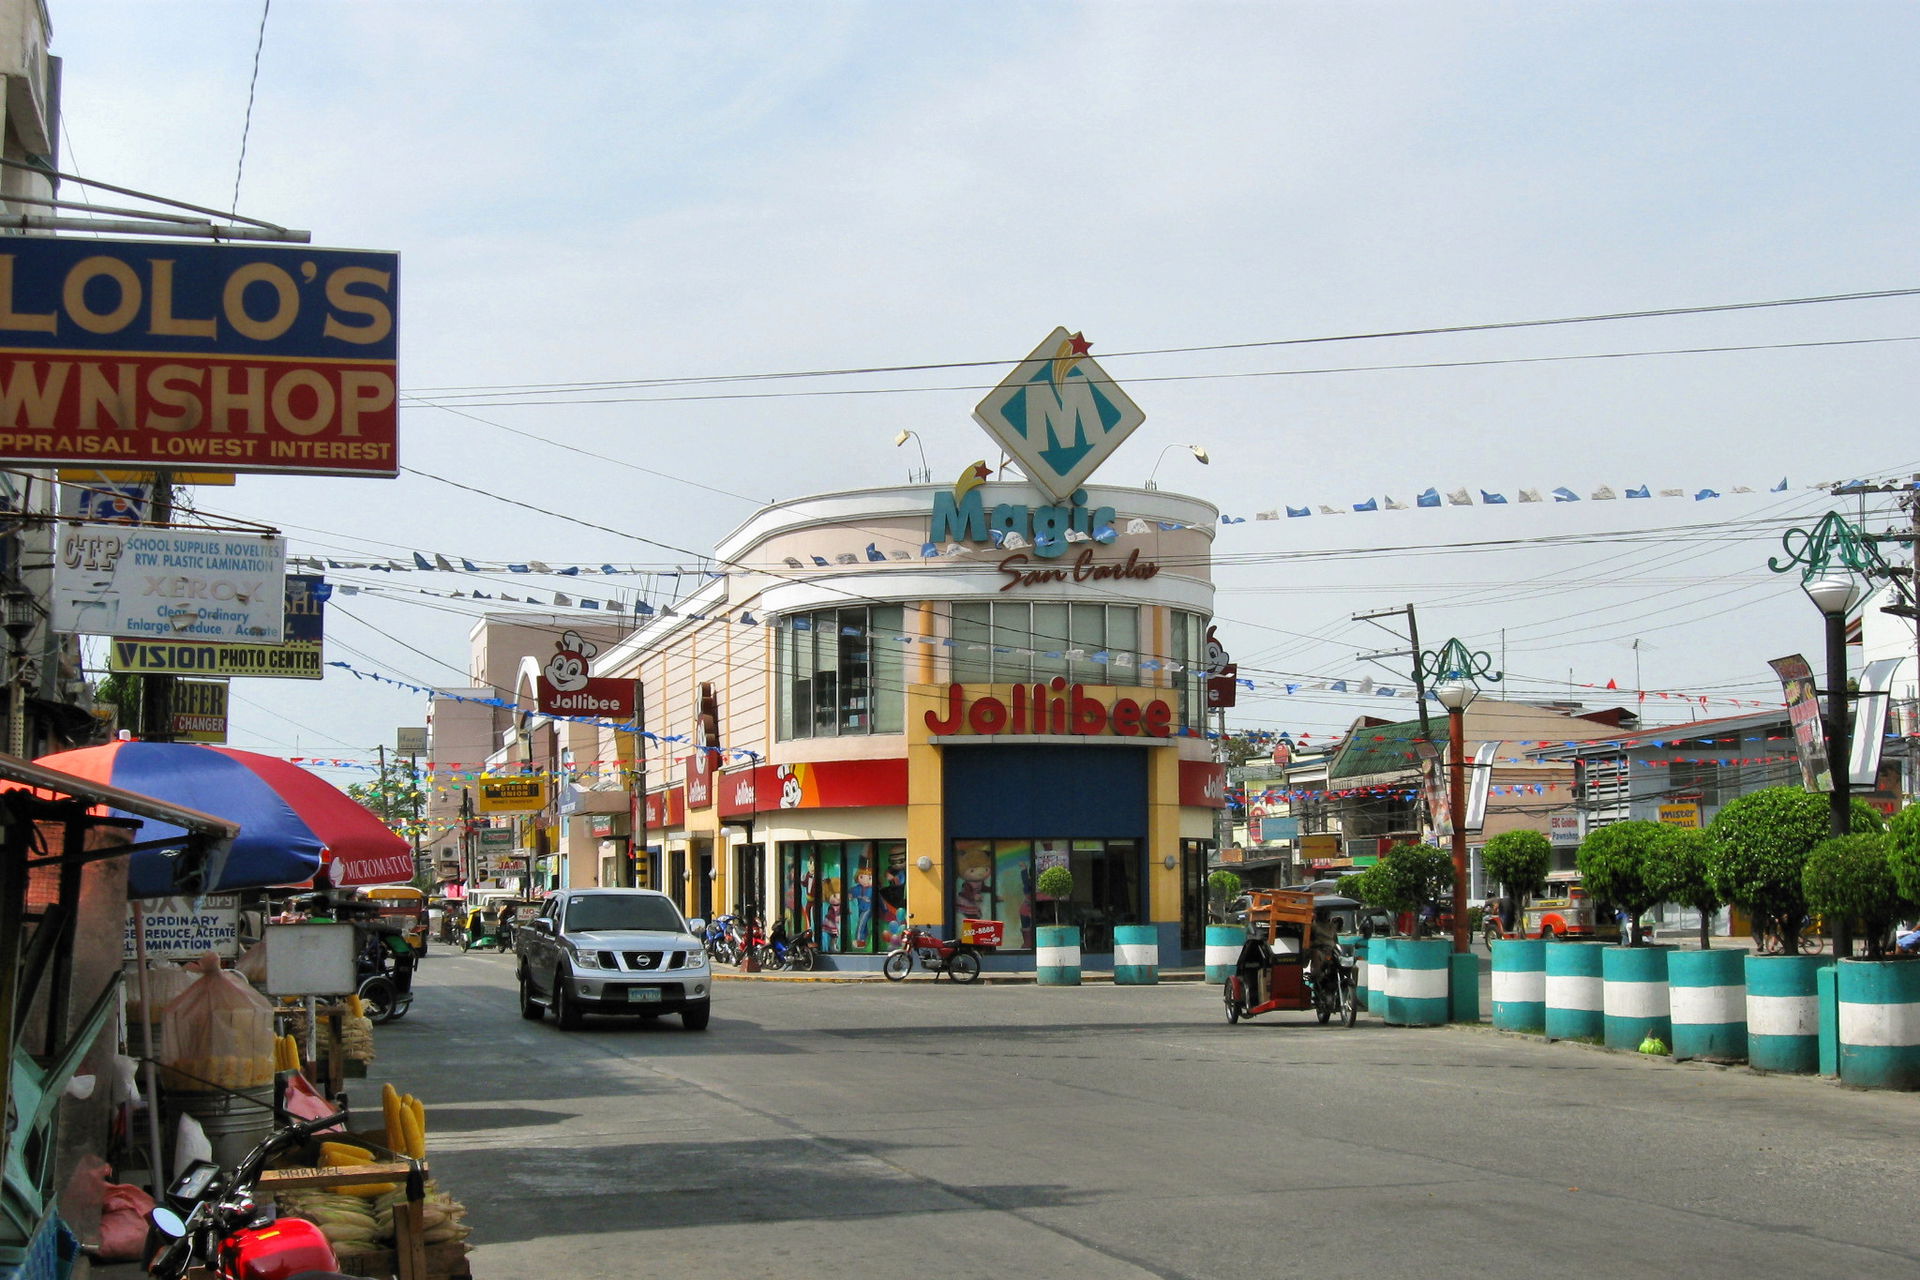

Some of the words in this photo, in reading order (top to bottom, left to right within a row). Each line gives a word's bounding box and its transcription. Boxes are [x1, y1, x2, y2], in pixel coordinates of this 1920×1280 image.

[0, 254, 392, 344] LOLO'S
[151, 437, 258, 457] LOWEST
[270, 440, 391, 460] INTEREST
[929, 487, 1116, 558] Magic
[128, 537, 169, 551] SCHOOL
[163, 555, 204, 569] PLASTIC
[206, 557, 273, 572] LAMINATION
[998, 554, 1067, 591] San
[1073, 548, 1161, 583] Carlos
[143, 576, 264, 602] XEROX
[197, 608, 250, 624] Ordinary
[127, 618, 170, 634] Enlarge
[219, 649, 266, 668] PHOTO
[269, 650, 320, 670] CENTER
[550, 694, 620, 710] Jollibee
[924, 676, 1172, 738] Jollibee
[179, 716, 224, 731] CHANGER
[346, 855, 412, 880] MICROMATIC
[146, 916, 219, 927] ORDINARY
[195, 927, 236, 939] ACETATE
